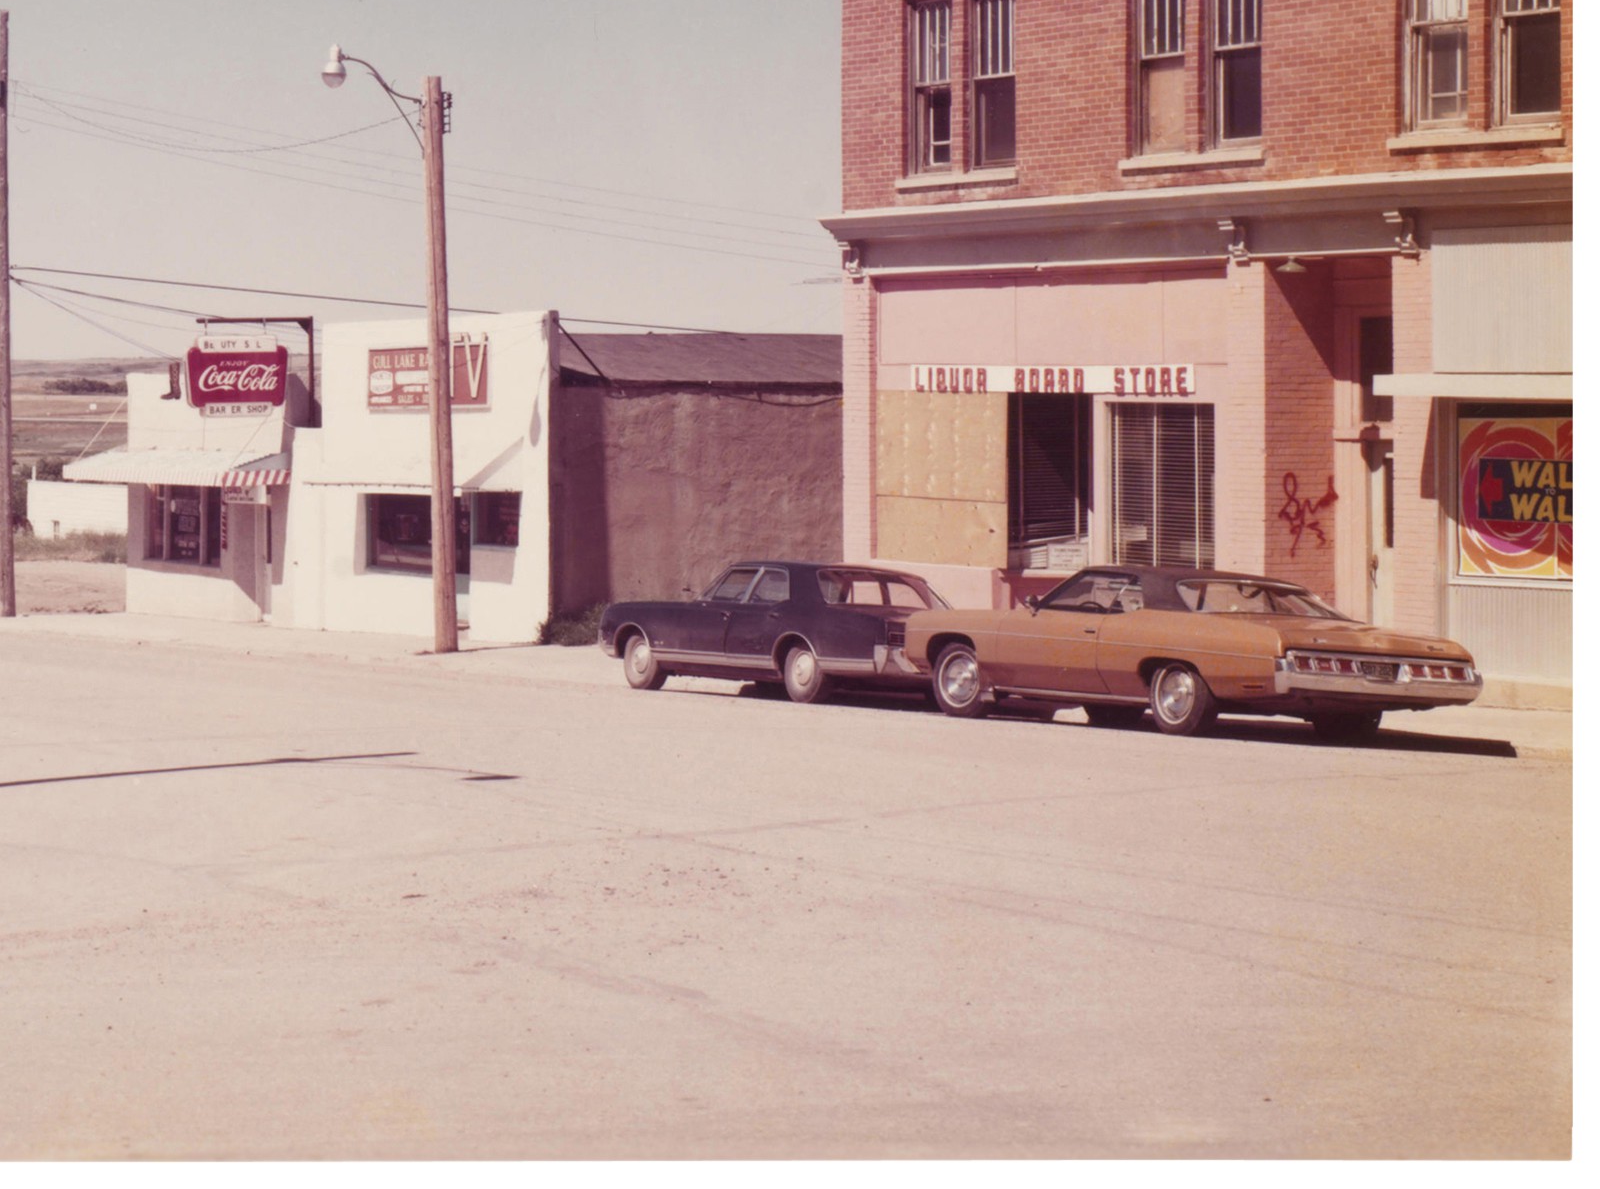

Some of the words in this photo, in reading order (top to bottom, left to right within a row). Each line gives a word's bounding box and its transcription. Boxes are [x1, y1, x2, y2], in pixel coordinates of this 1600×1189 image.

[198, 364, 280, 392] Coca-Cola
[915, 366, 987, 394] LIQUOR
[1015, 367, 1084, 393] BOARD
[1114, 366, 1188, 397] STORE
[247, 404, 268, 413] SHOP
